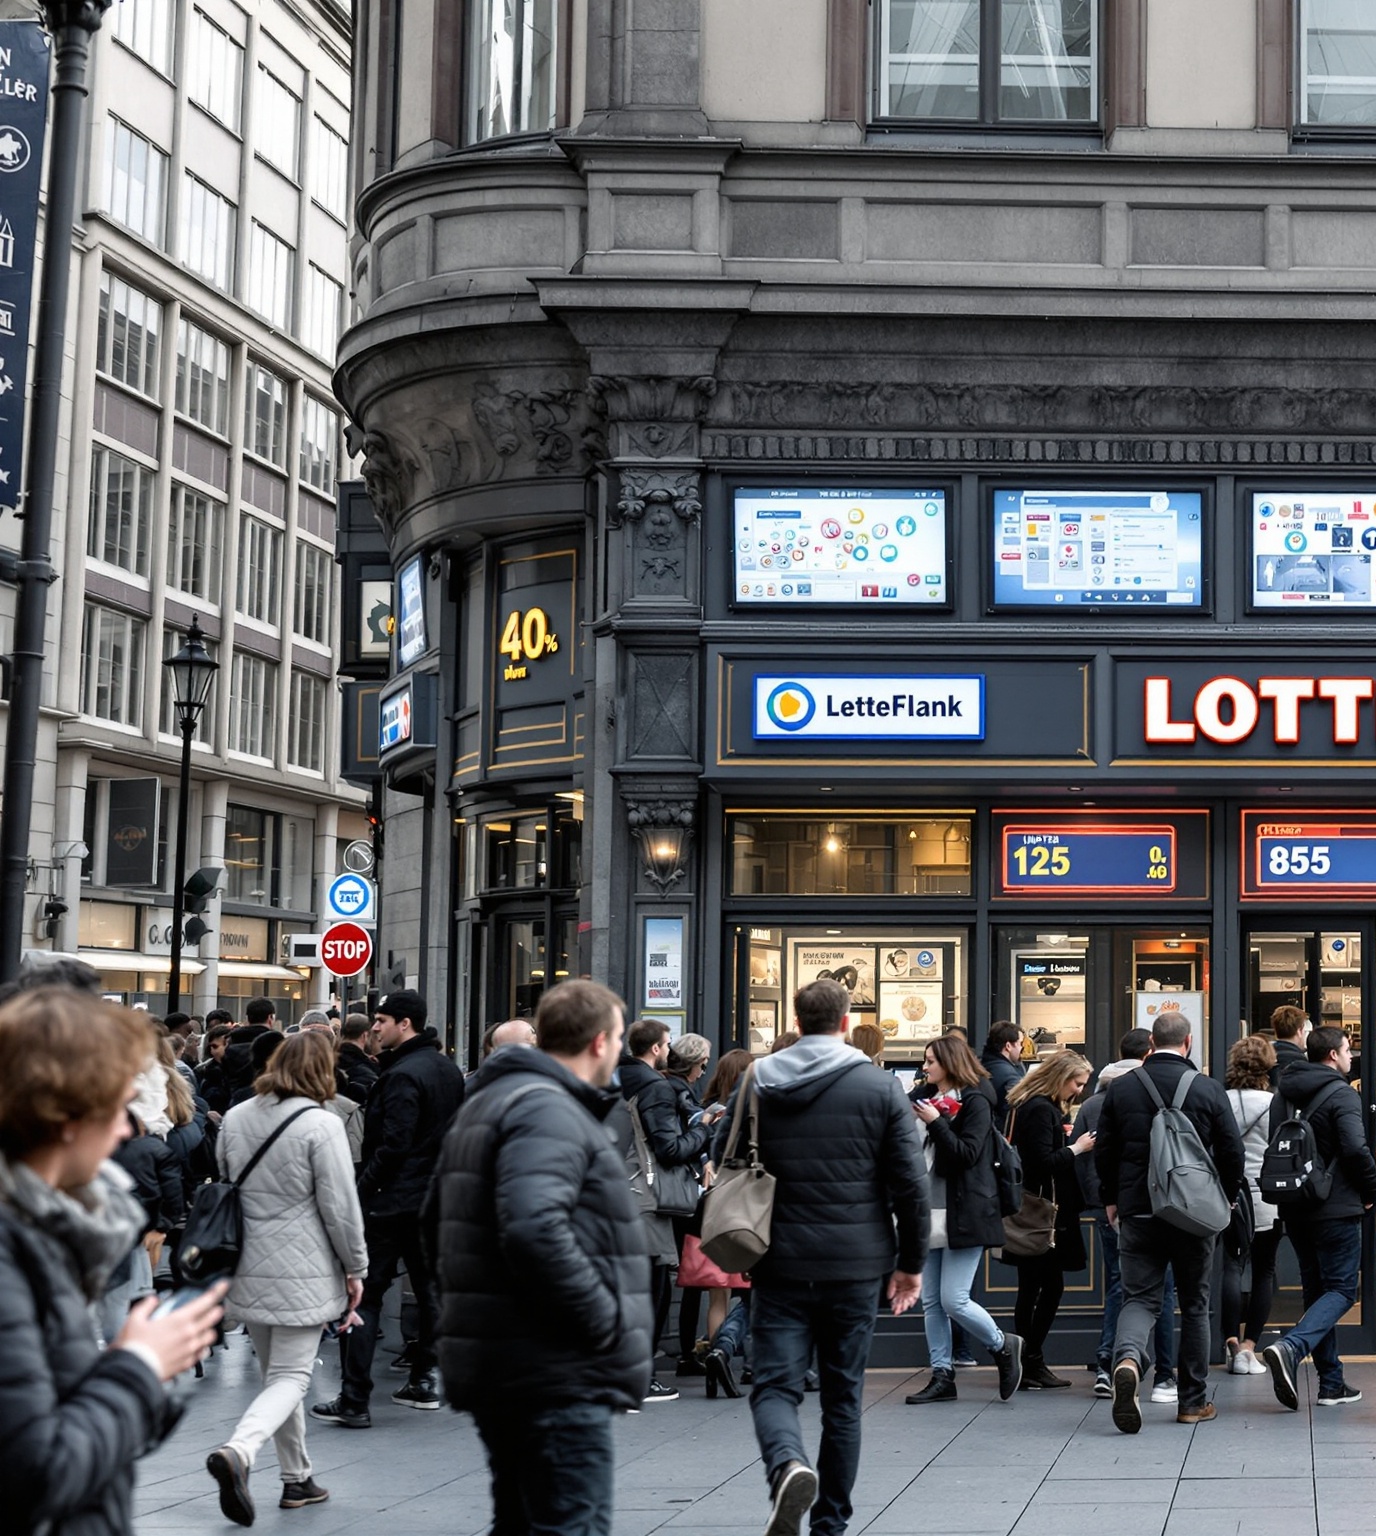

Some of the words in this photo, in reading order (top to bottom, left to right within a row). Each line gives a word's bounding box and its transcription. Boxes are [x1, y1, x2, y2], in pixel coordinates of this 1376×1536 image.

[826, 694, 963, 717] LetteFlank
[1013, 845, 1071, 876] 125
[1269, 846, 1332, 875] 855
[324, 940, 367, 960] STOP
